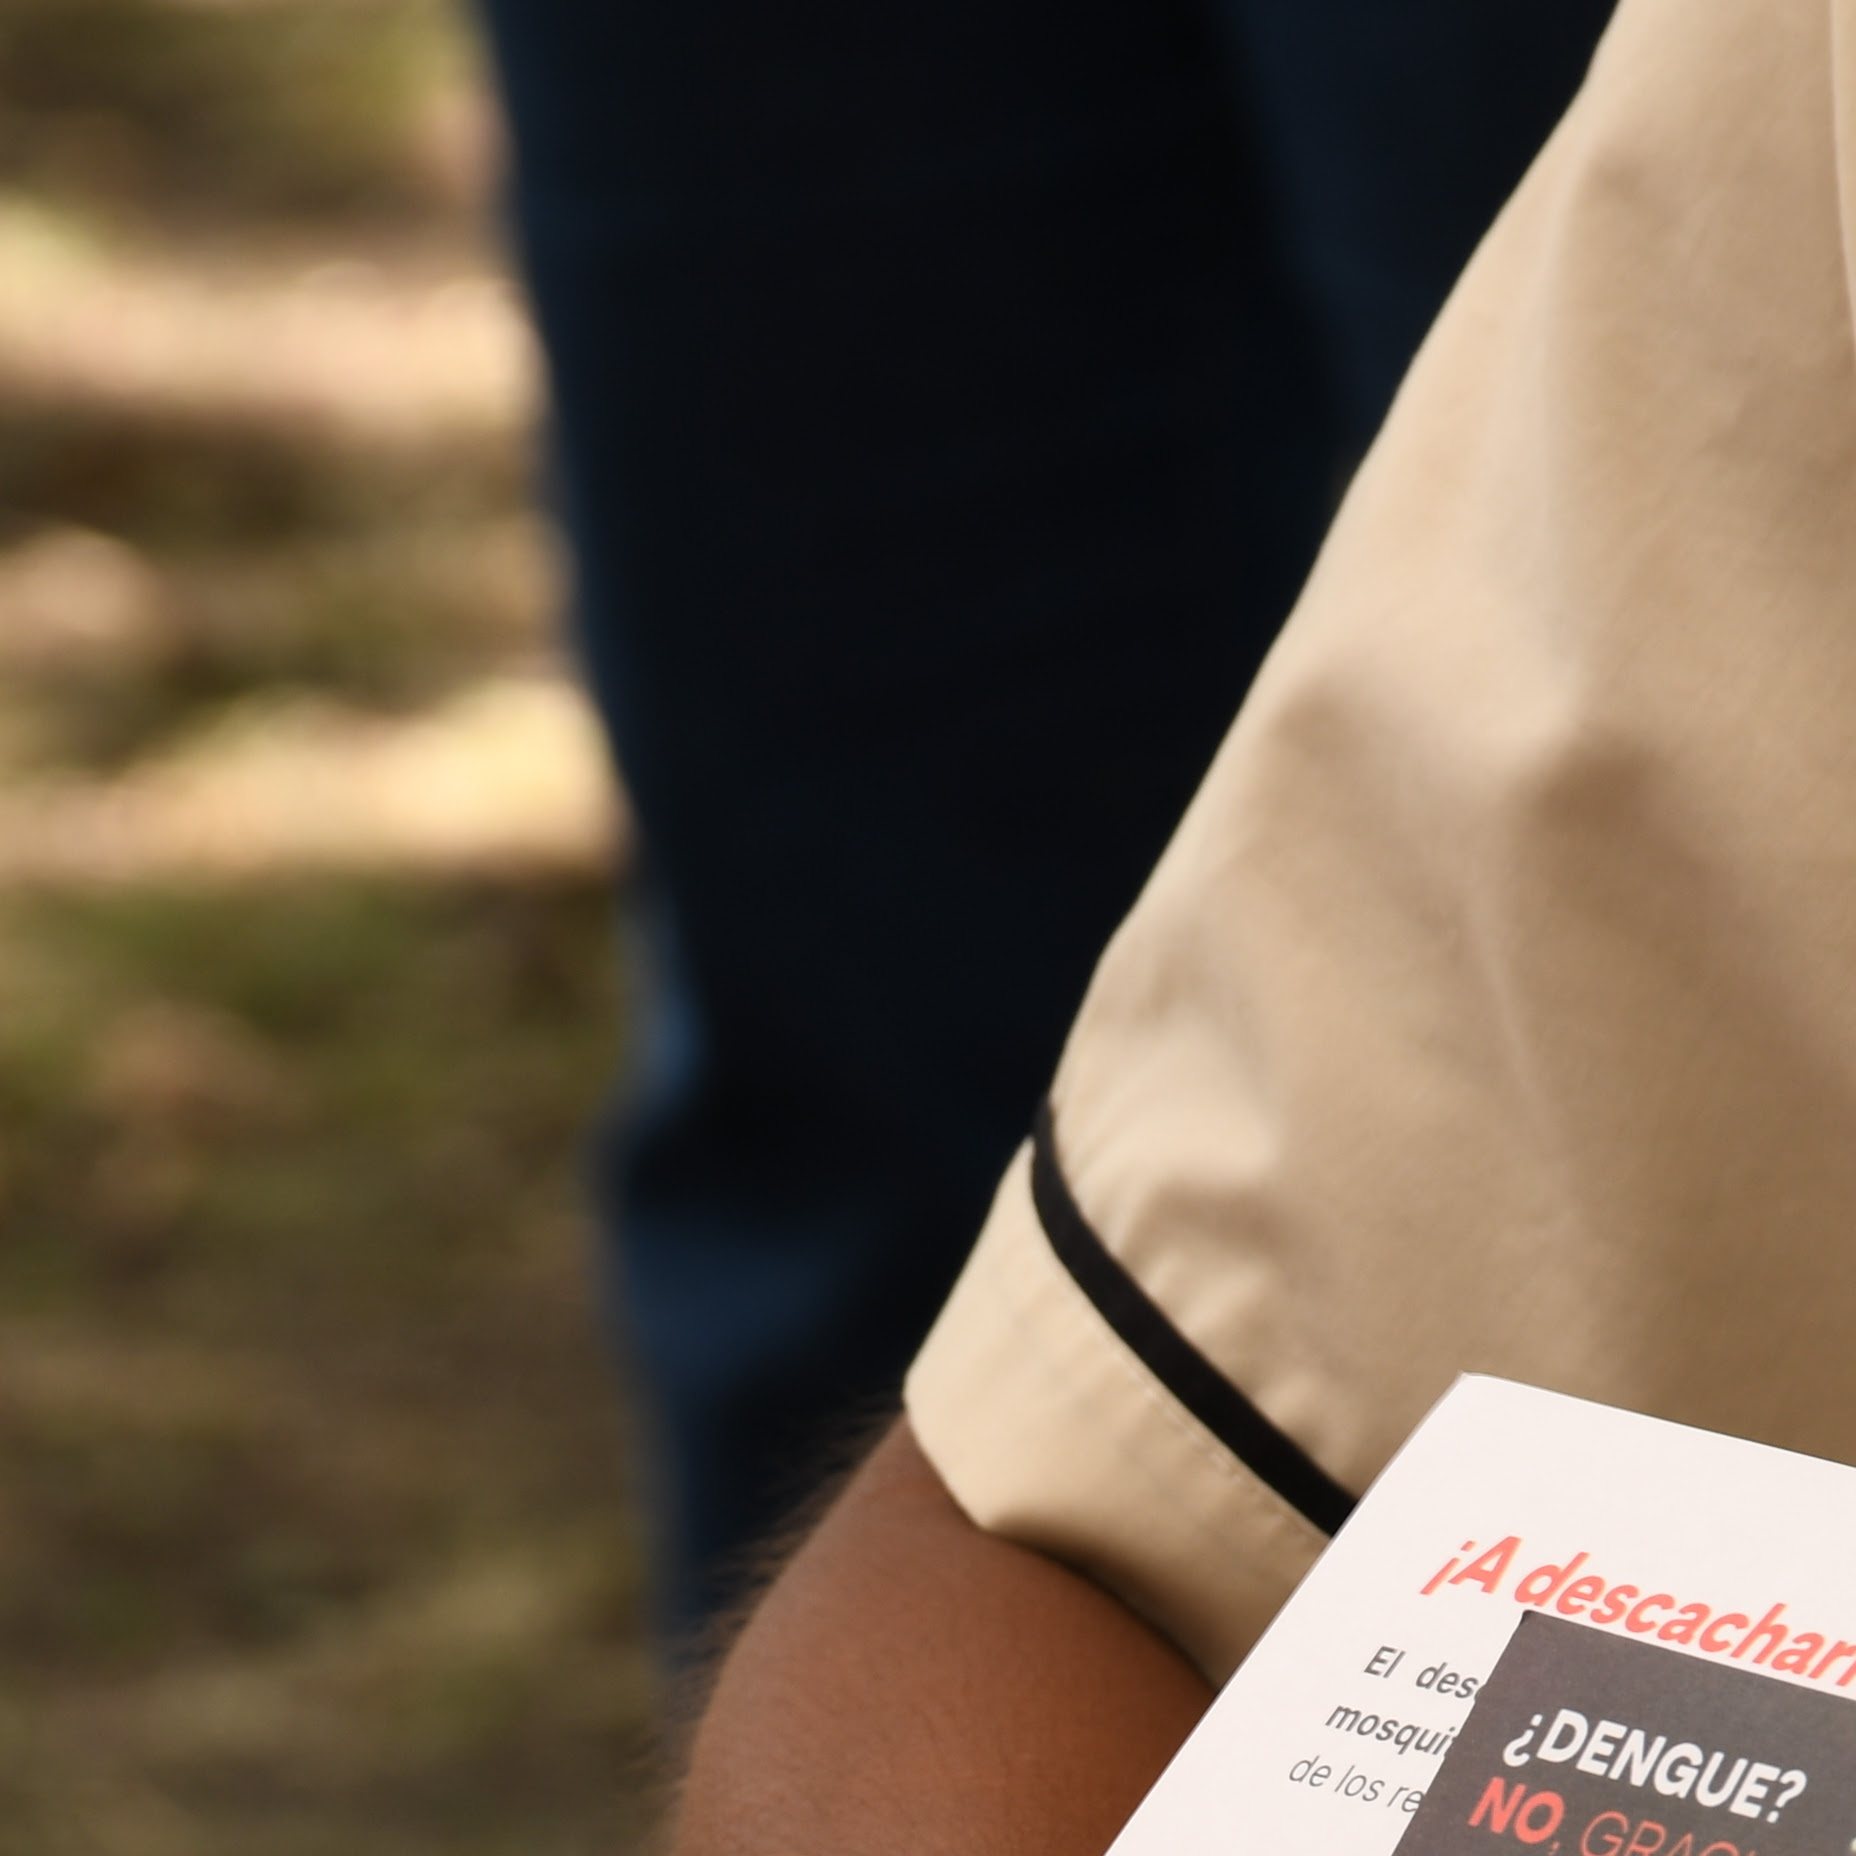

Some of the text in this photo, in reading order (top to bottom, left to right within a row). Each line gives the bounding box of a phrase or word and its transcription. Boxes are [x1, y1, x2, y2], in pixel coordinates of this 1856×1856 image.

[1419, 1536, 1524, 1595] ¡A
[1364, 1645, 1486, 1701] El des
[1325, 1705, 1457, 1756] mosqui
[1289, 1755, 1426, 1813] de los re
[1503, 1708, 1807, 1824] ¿DENGUE?
[1469, 1776, 1565, 1856] NO,
